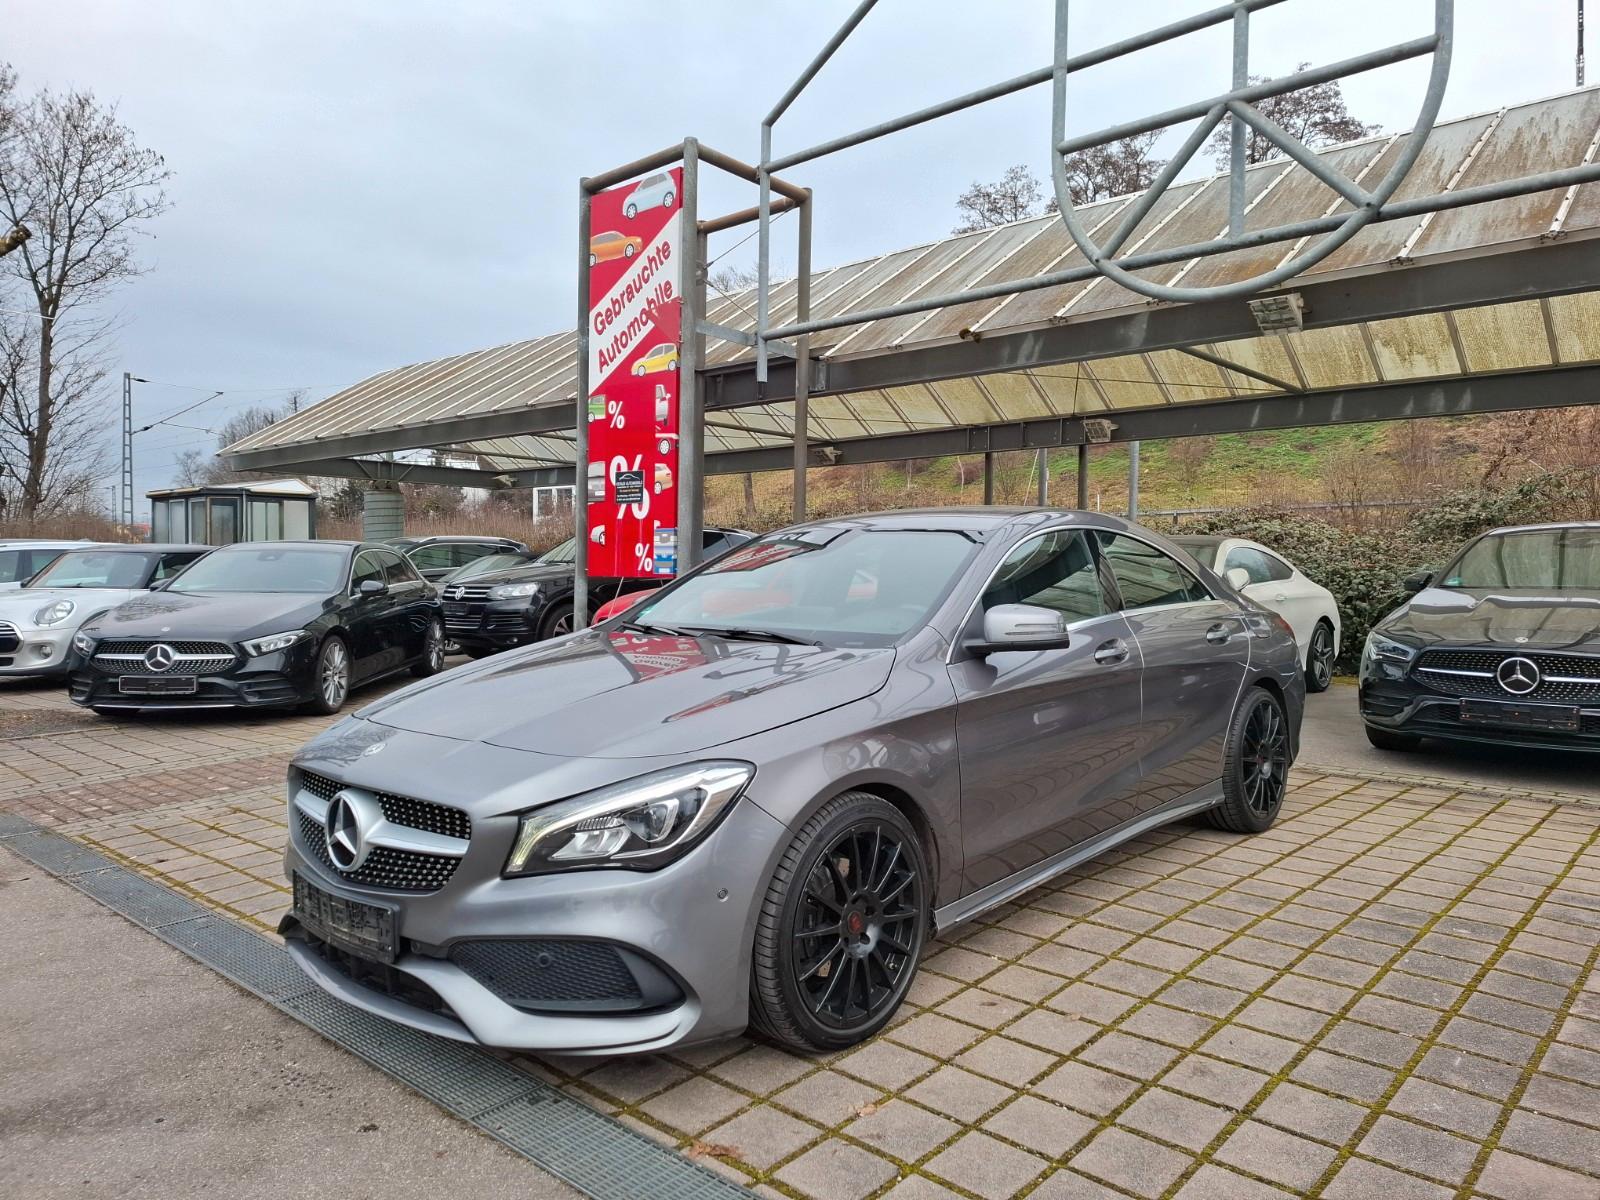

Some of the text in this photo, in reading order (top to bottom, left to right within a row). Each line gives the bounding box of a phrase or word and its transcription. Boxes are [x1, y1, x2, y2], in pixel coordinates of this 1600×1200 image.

[593, 240, 672, 336] Gebrauchte
[597, 279, 673, 374] Automobile
[608, 400, 625, 429] %
[635, 543, 653, 572] %
